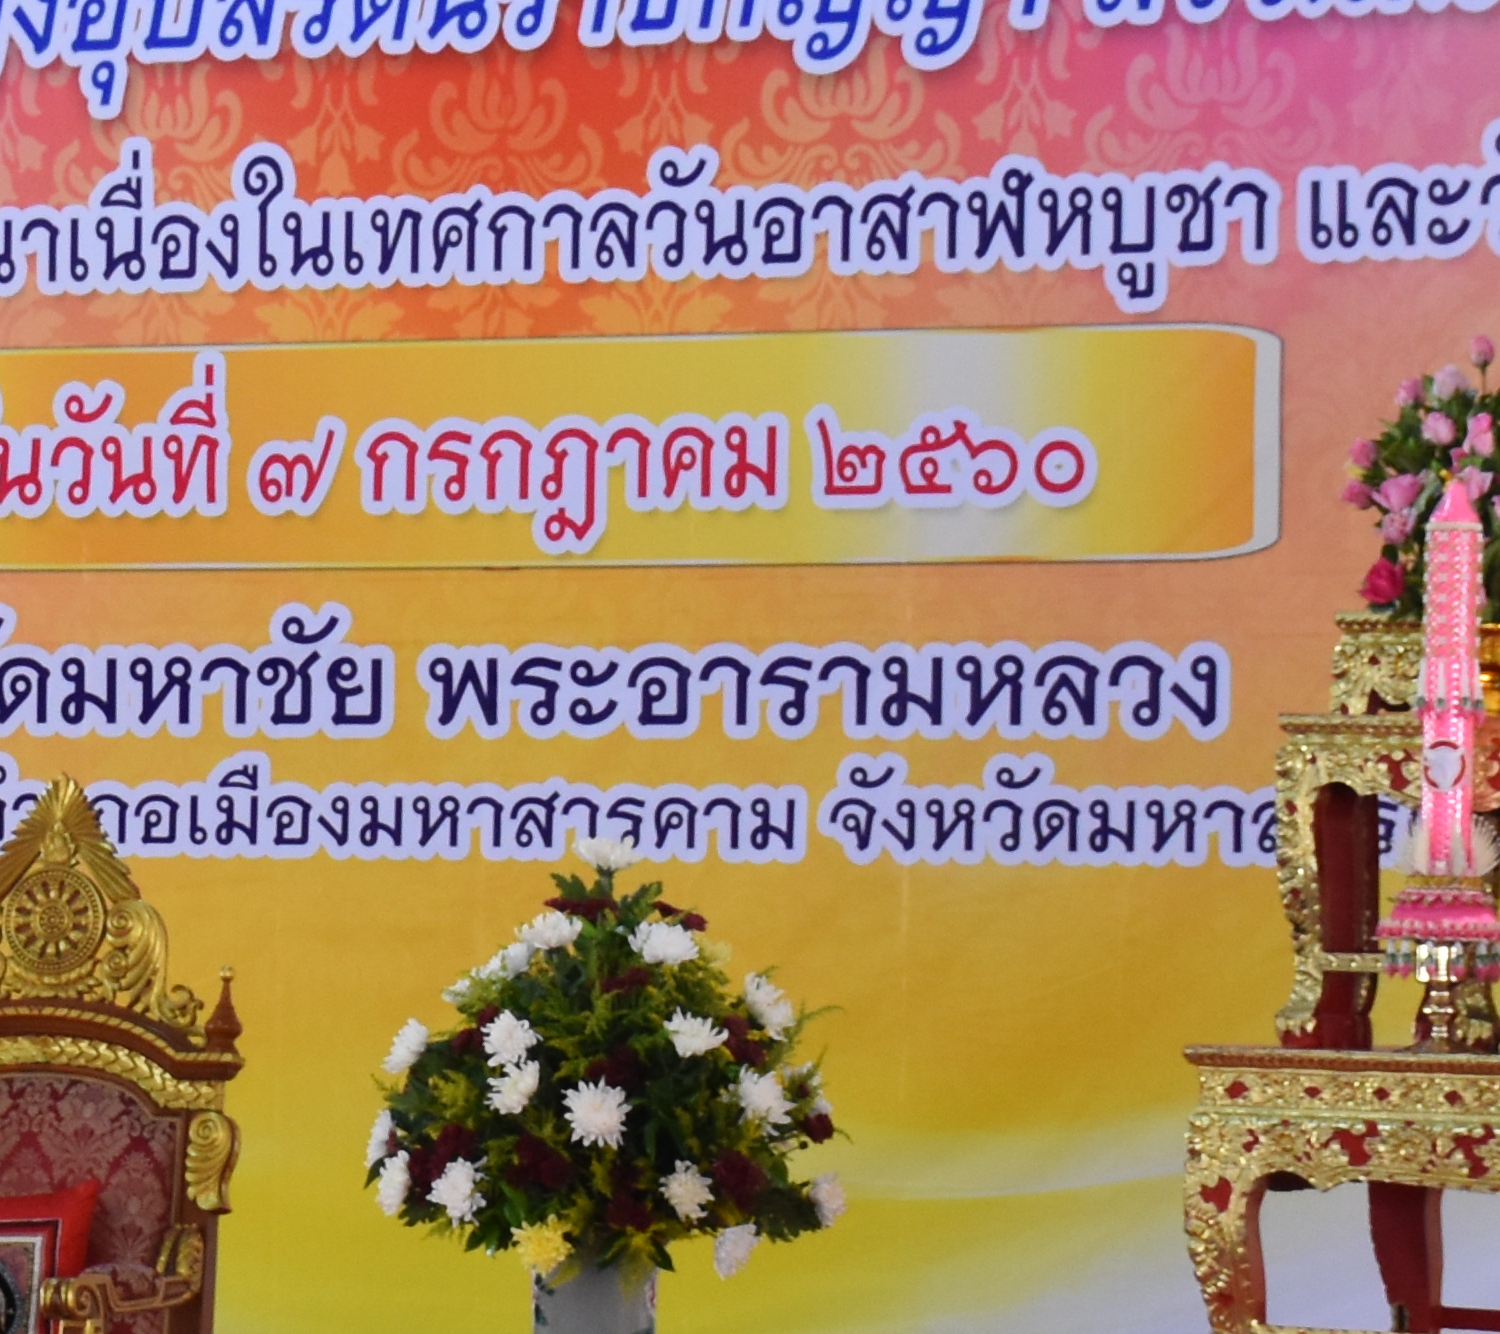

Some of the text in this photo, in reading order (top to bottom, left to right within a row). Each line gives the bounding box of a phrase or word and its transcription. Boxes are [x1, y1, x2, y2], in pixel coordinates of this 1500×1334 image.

[258, 422, 336, 504] ๗
[366, 420, 777, 542] กรกฎาคม
[818, 420, 1086, 495] ๒๕๖๐
[428, 653, 1218, 727] พระอารามหลวง
